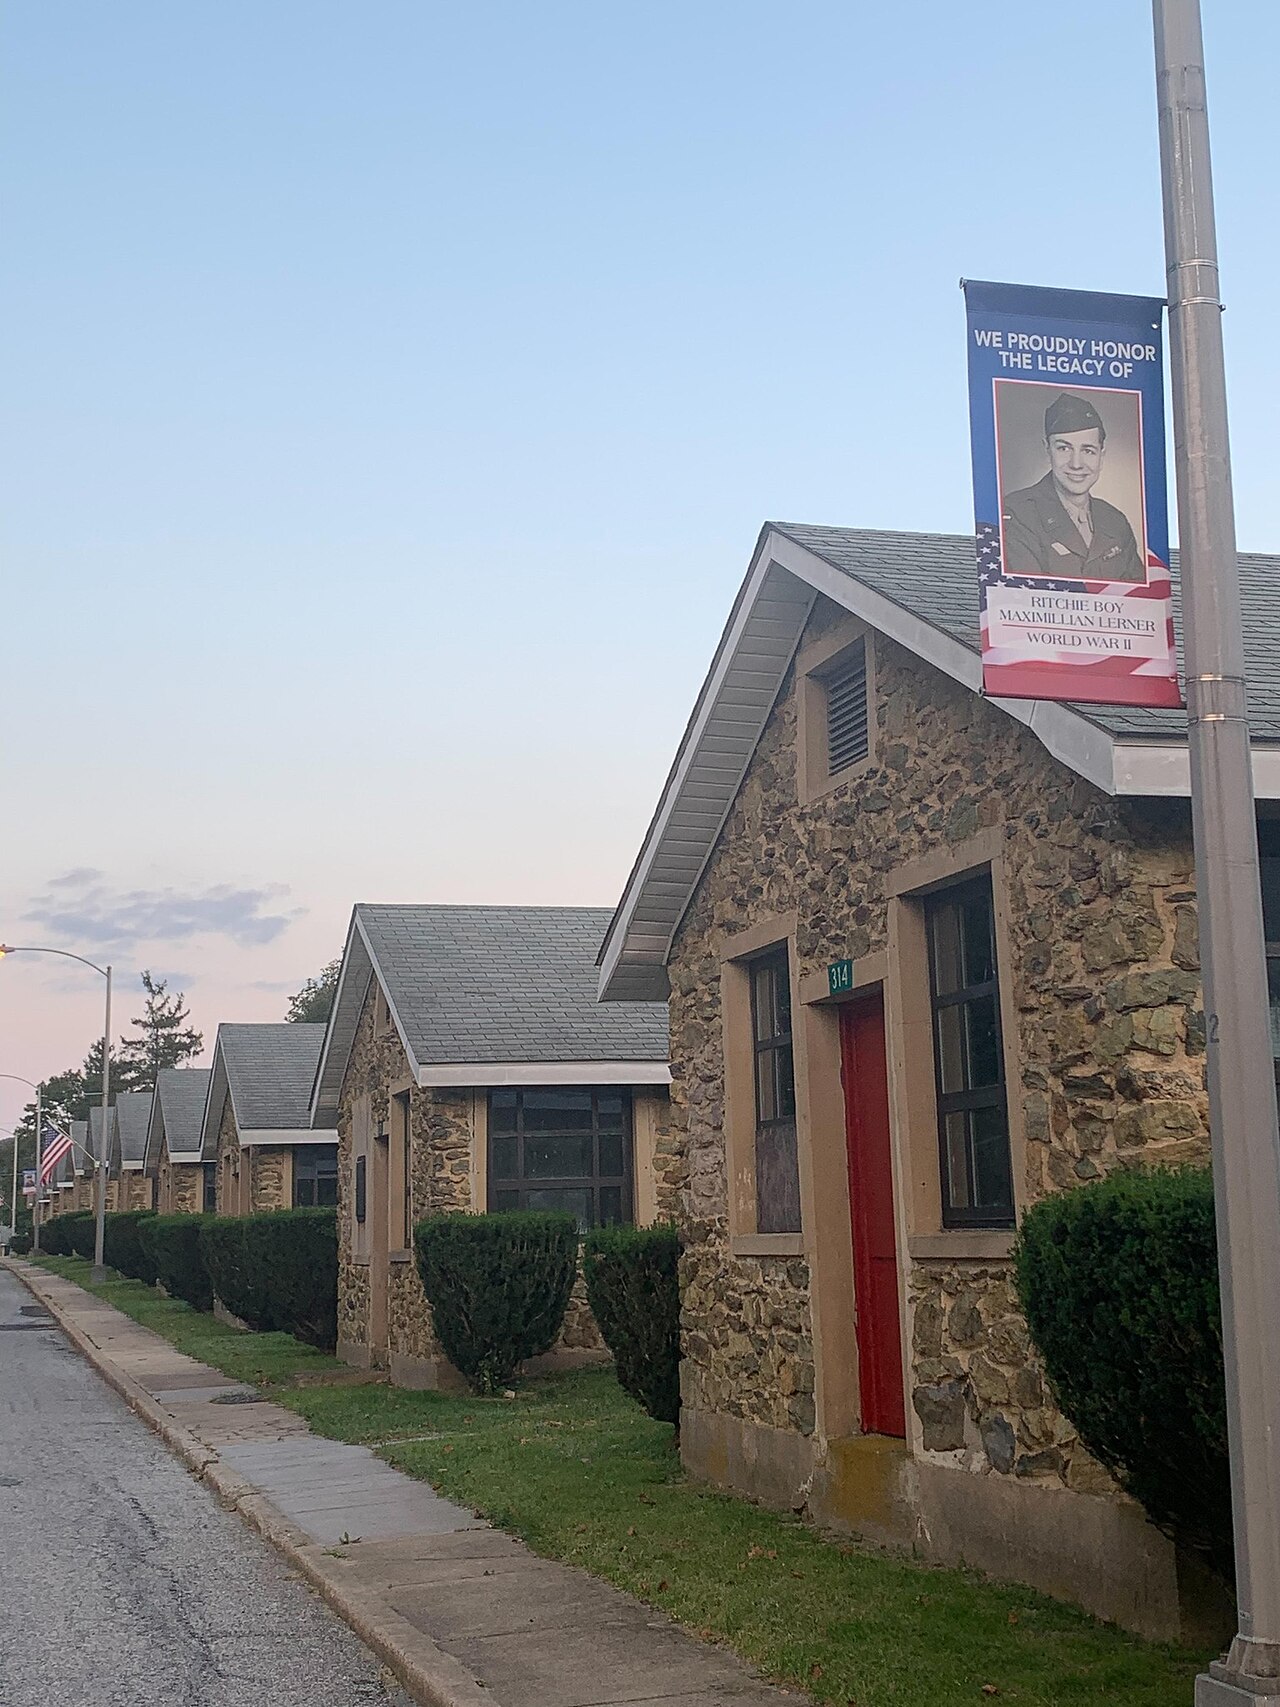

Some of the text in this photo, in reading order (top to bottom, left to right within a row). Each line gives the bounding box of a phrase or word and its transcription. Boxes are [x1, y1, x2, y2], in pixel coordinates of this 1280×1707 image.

[974, 329, 1156, 362] WE PROUDLY HONOR
[999, 351, 1133, 379] THE LEGACY OF
[1031, 596, 1124, 614] RITCHIE BOY
[999, 609, 1156, 632] MAXIMILLIAN LERNER
[1027, 632, 1132, 650] WORLD WAR II
[831, 964, 848, 989] 314
